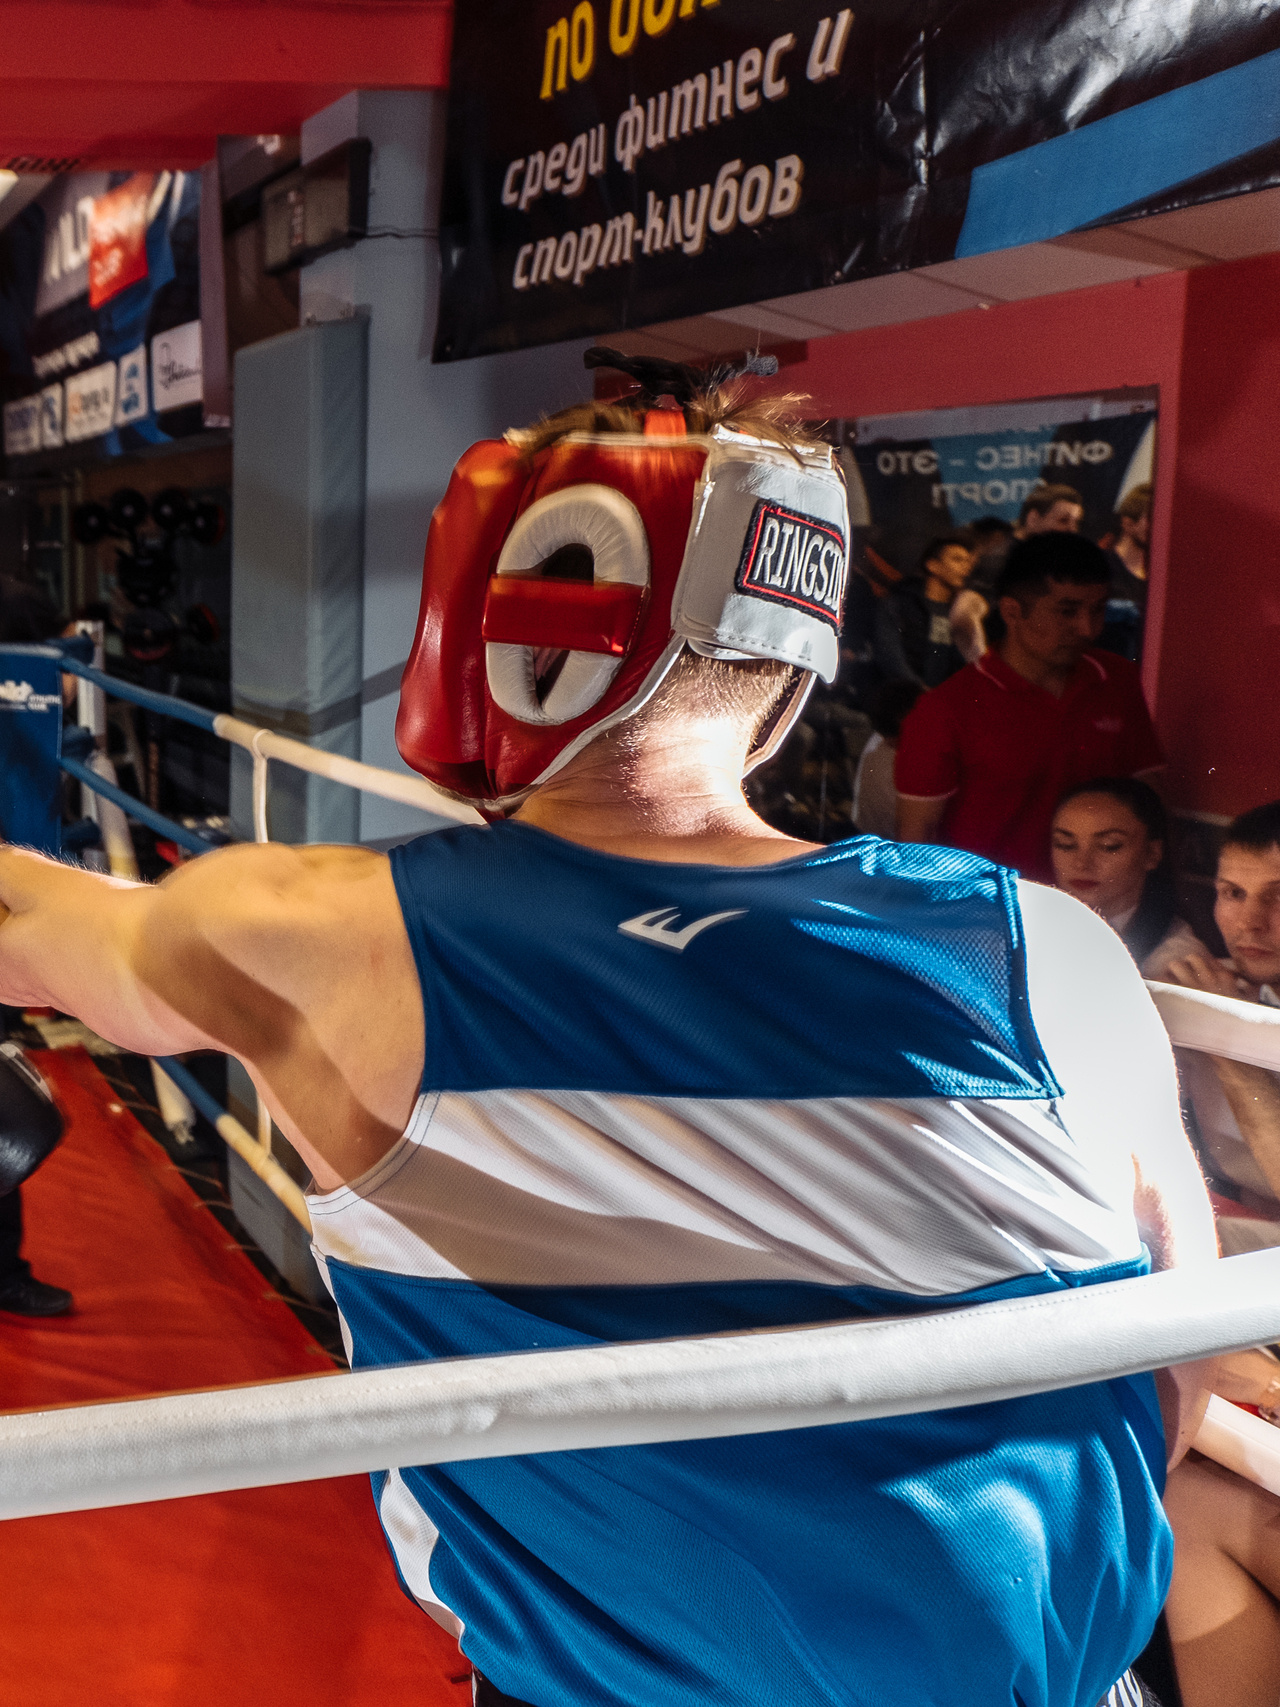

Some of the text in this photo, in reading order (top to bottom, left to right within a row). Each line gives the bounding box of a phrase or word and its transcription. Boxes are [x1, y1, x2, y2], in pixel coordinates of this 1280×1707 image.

[501, 122, 607, 211] среди
[614, 32, 797, 173] фитнес
[806, 8, 854, 83] и
[539, 0, 595, 100] по
[512, 153, 804, 290] спорт-клубов
